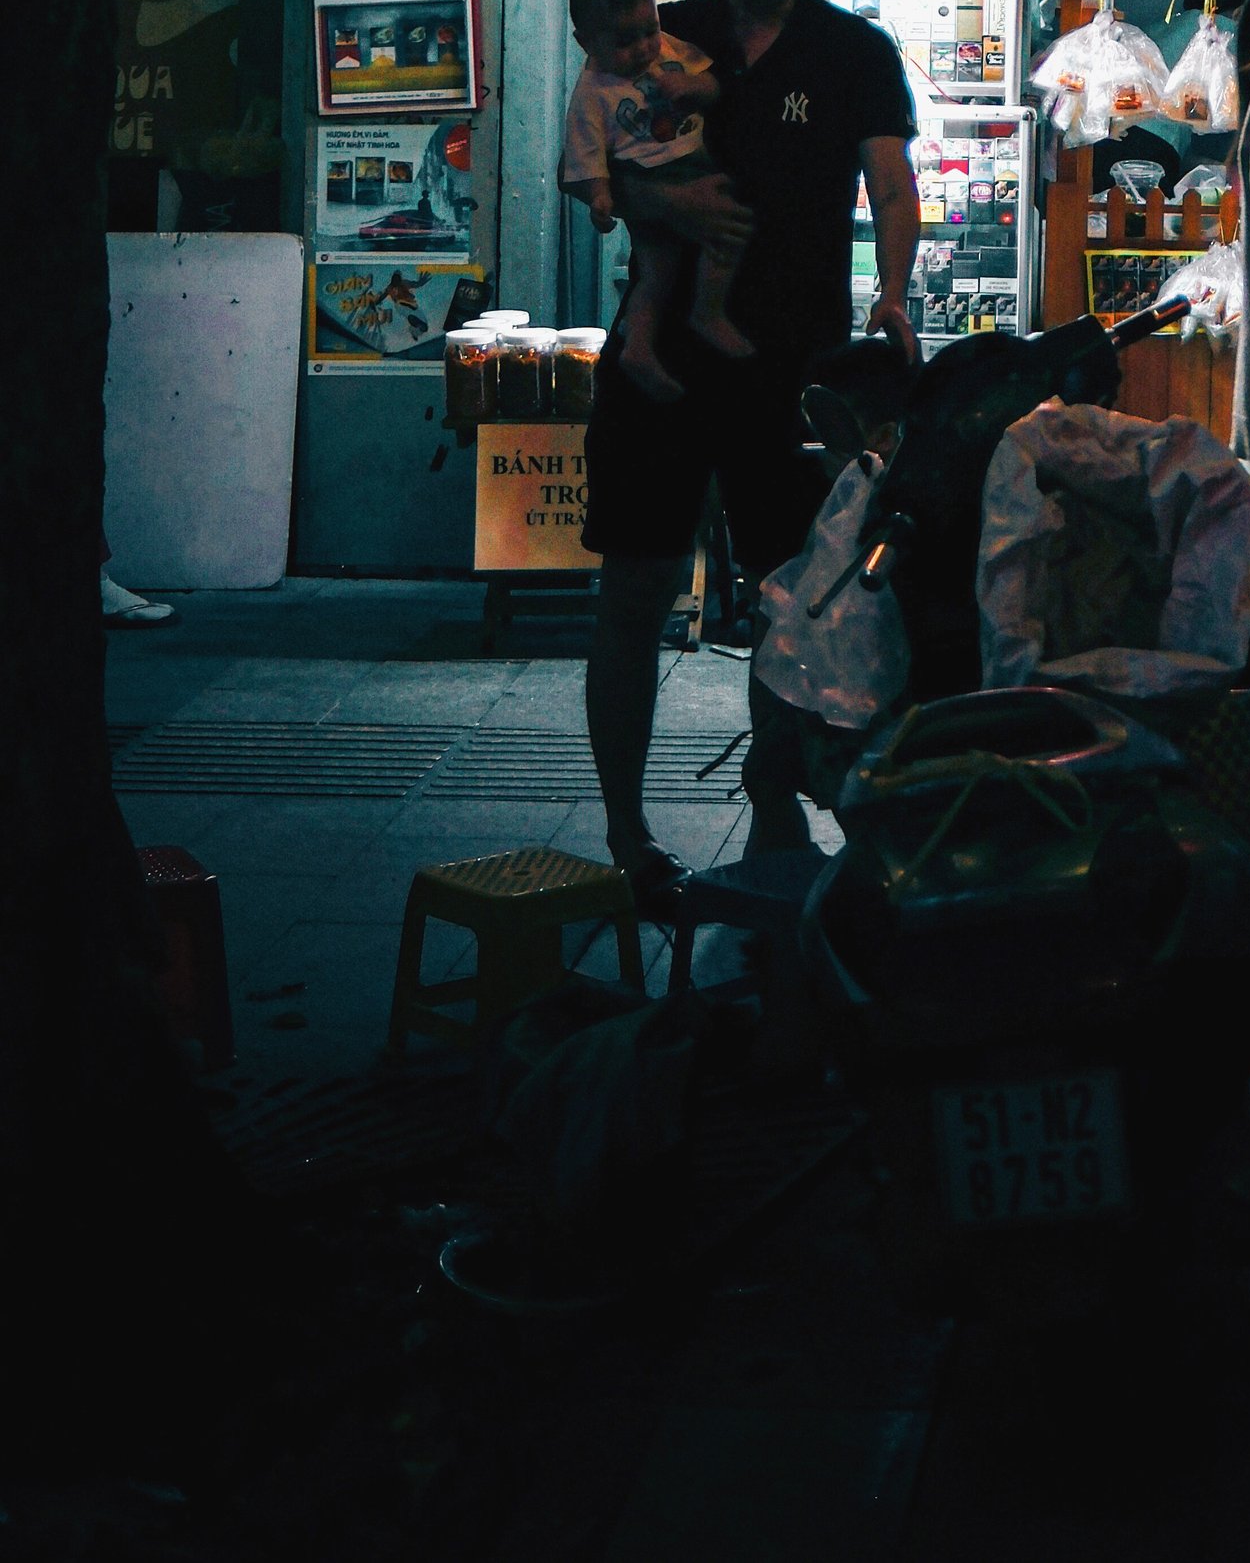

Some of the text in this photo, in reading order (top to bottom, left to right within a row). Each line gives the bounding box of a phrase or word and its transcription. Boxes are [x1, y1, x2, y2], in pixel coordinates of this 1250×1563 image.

[492, 450, 564, 474] BÁNH
[526, 508, 548, 526] ÚT
[970, 1148, 1103, 1217] 8759
